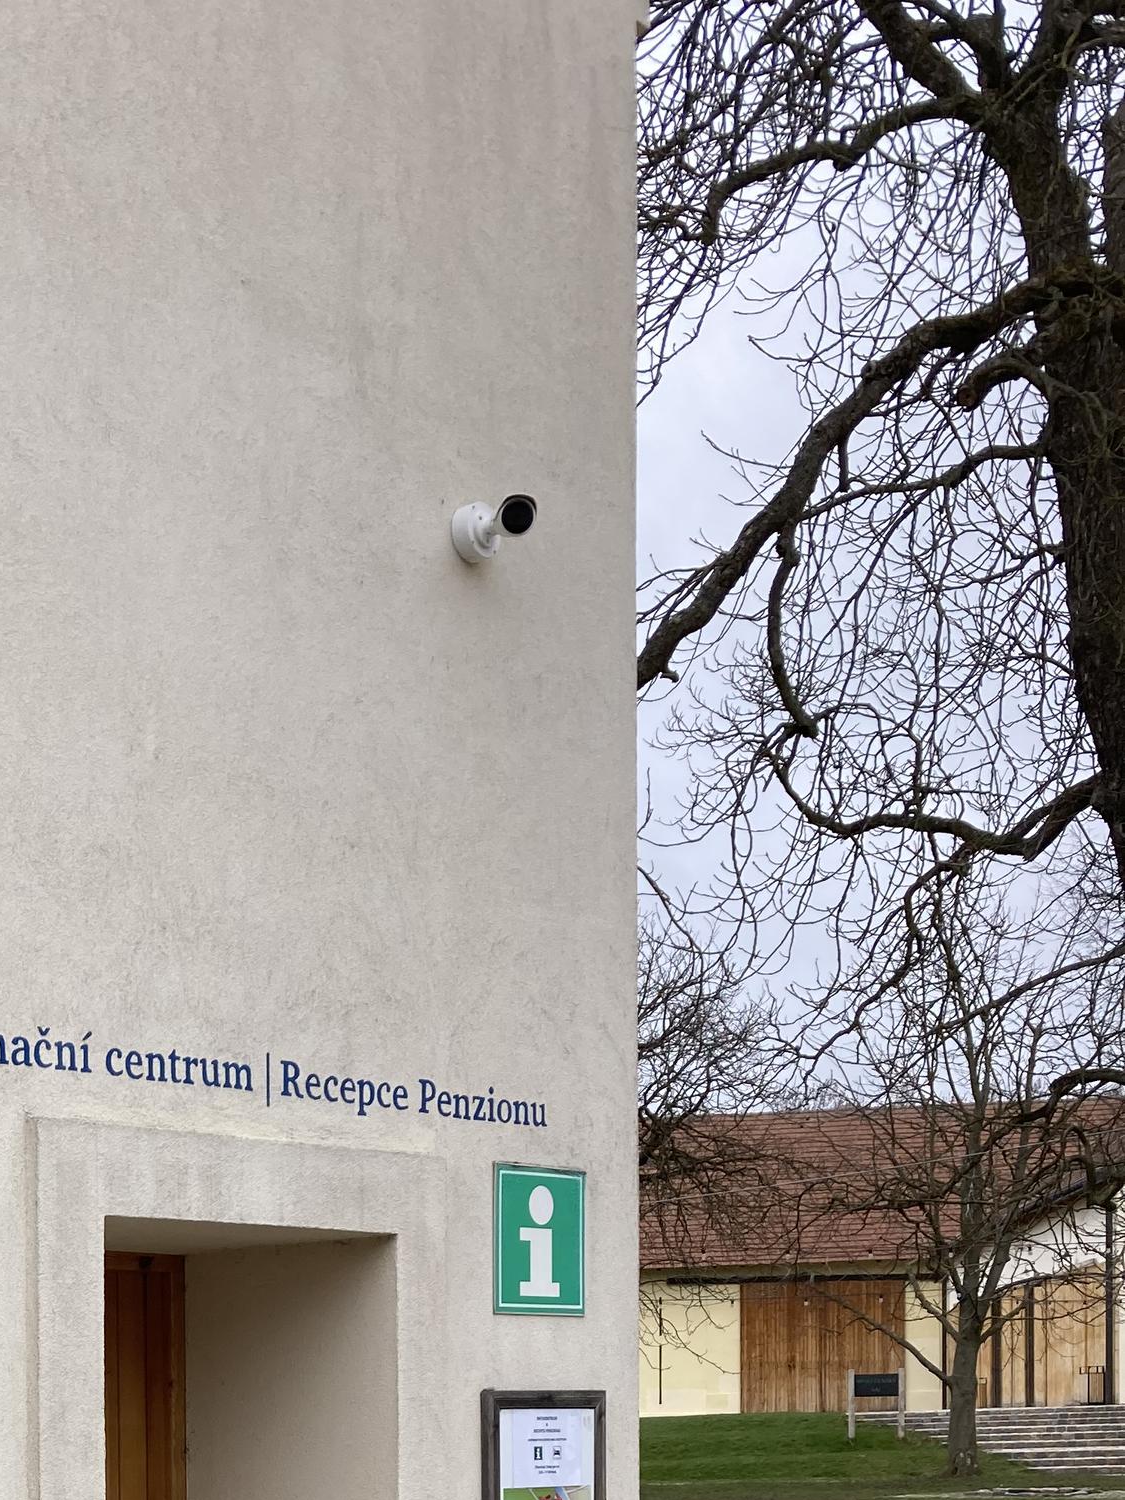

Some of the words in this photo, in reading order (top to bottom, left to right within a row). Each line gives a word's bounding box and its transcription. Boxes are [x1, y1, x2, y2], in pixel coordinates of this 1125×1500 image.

[104, 1048, 253, 1092] centrum
[280, 1060, 409, 1117] Recepce
[418, 1078, 547, 1128] Penzionu
[519, 1185, 561, 1298] i
